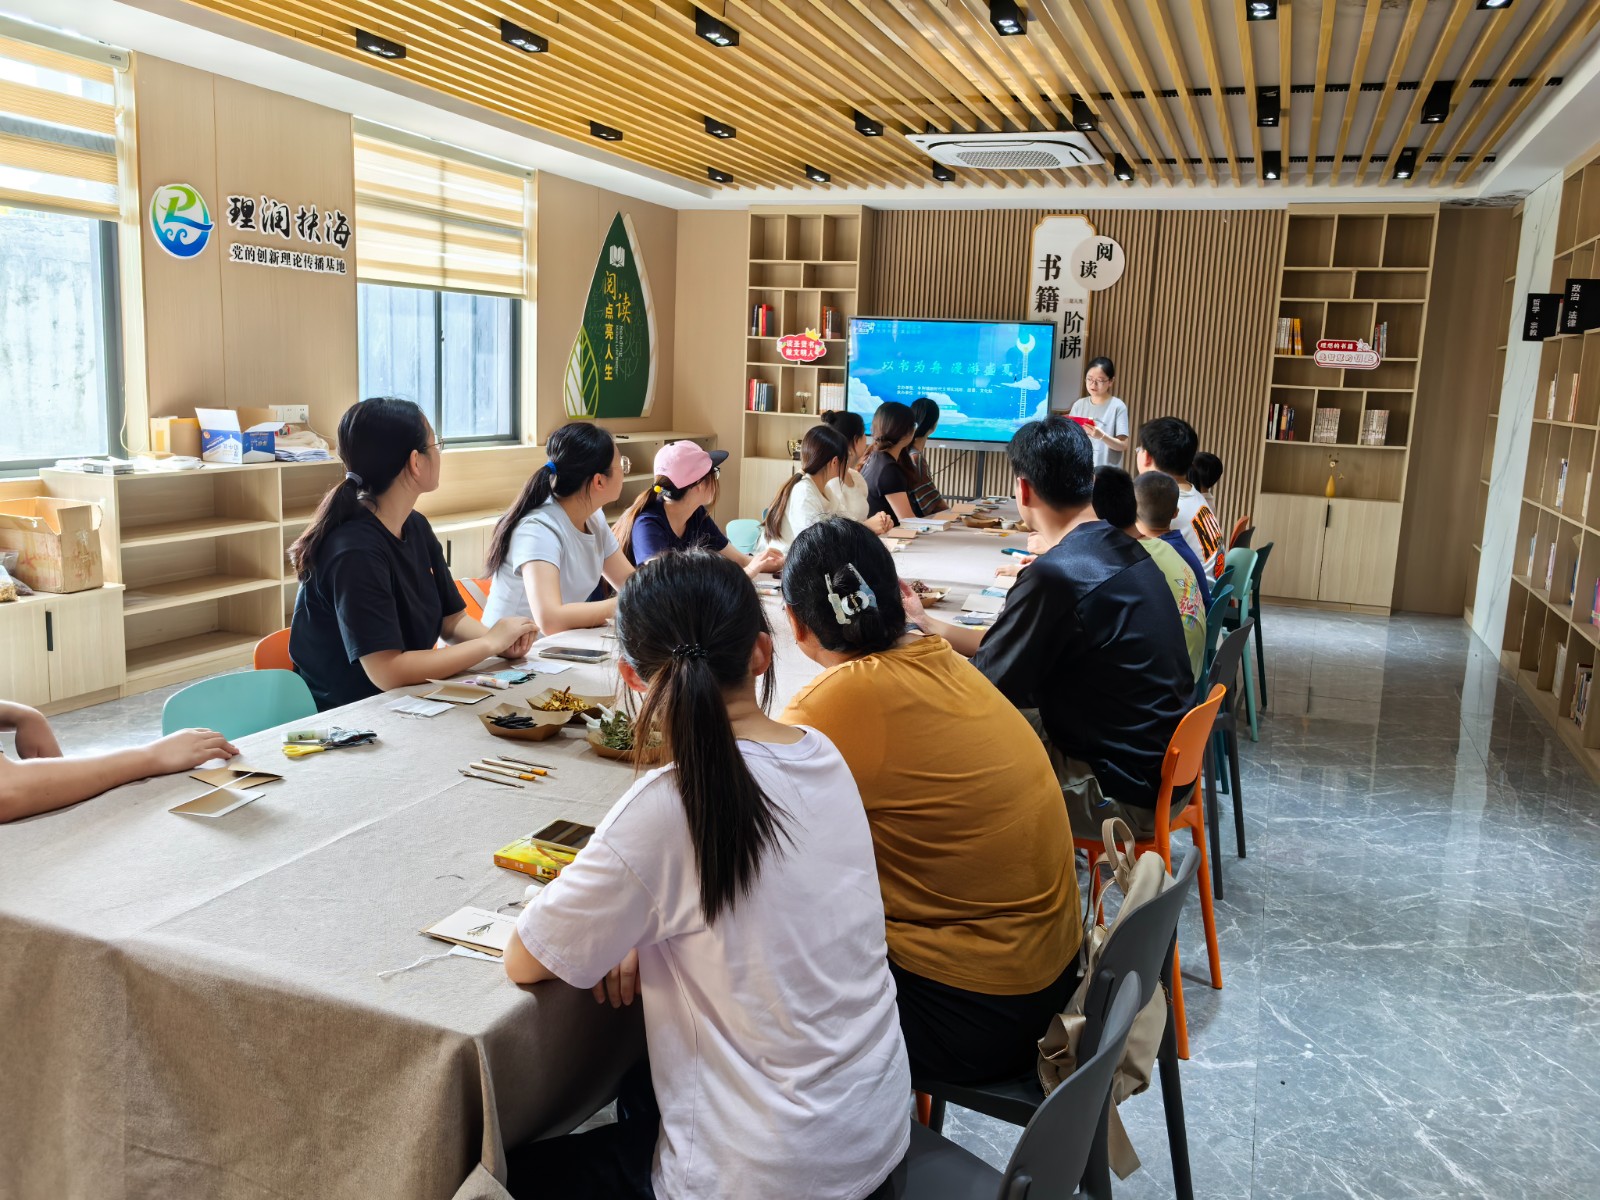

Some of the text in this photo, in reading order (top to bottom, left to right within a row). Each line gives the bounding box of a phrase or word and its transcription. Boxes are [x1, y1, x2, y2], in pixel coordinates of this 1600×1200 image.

[228, 197, 351, 249] 理润扶海
[232, 245, 346, 274] 党的创新理论传播基地
[1034, 253, 1062, 313] 书籍
[1079, 242, 1114, 279] 阅读
[604, 271, 631, 324] 阅读
[604, 303, 614, 381] 点亮人生
[1059, 310, 1084, 359] 阶梯
